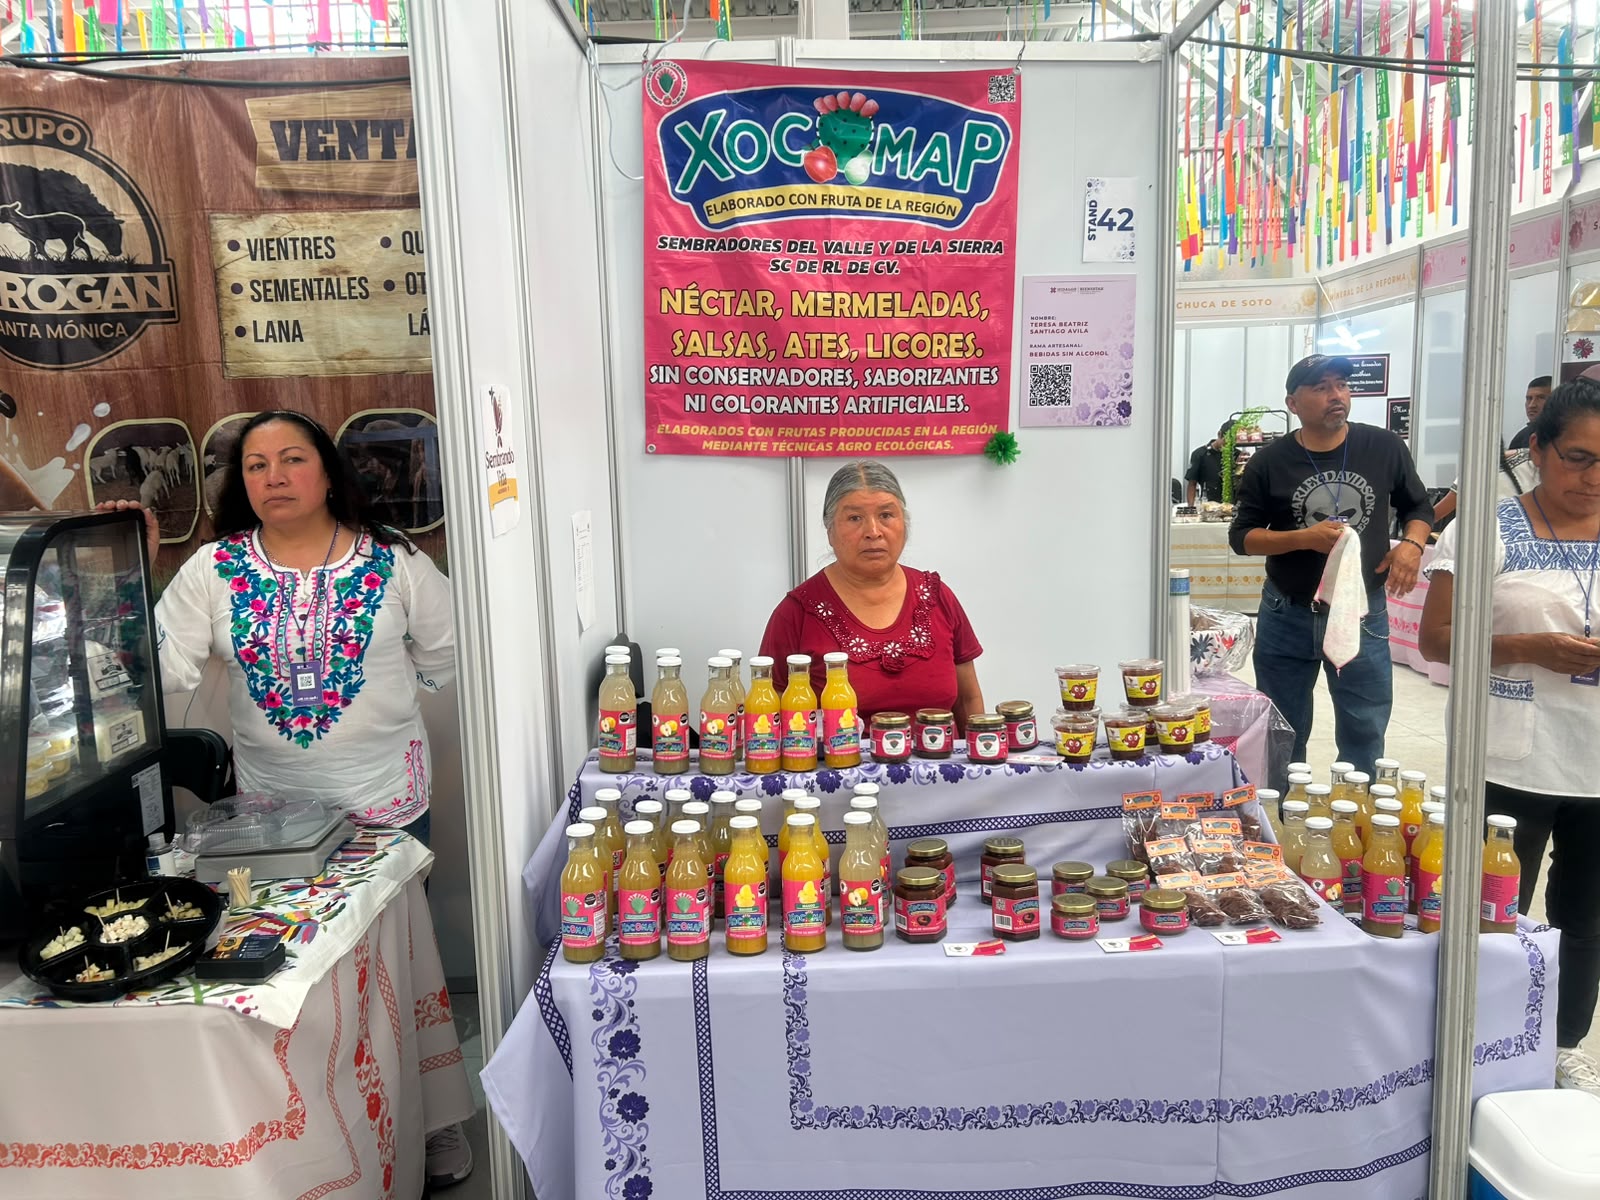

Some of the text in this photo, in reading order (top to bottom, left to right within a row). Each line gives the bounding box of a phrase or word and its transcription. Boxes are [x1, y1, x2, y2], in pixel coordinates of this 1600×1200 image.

[706, 192, 957, 218] ELABORADO CON FRUTA DE LA REGIÓN
[1087, 199, 1098, 241] STAND
[1097, 207, 1135, 232] 42
[246, 235, 336, 262] VIENTRES
[658, 236, 1004, 255] SEMBRADORES DEL VALLE Y DE LA SIERRA
[769, 258, 900, 274] SC DE RL DE CV.
[250, 276, 370, 303] SEMENTALES
[1356, 284, 1364, 294] DE
[1366, 282, 1373, 292] LA
[1375, 272, 1407, 288] REFORMA
[660, 282, 990, 321] NÉCTAR, MERMELADAS,
[1176, 298, 1273, 309] CHUCA DE SOTO
[45, 319, 129, 340] MÓNICA
[253, 319, 304, 344] LANA
[671, 329, 984, 362] SALSAS, ATES, LICORES.
[649, 364, 1000, 389] SIN CONSERVADORES, SABORIZANTES
[684, 394, 970, 415] NI COLORANTES ARTIFICIALES.
[657, 421, 999, 438] ELABORADOS CON FRUTAS PRODUCIDAS EN LA REGIÓN
[702, 437, 955, 453] MEDIANTE TÉCNICAS AGRO ECOLÓGICAS.
[485, 446, 515, 469] Sembrando
